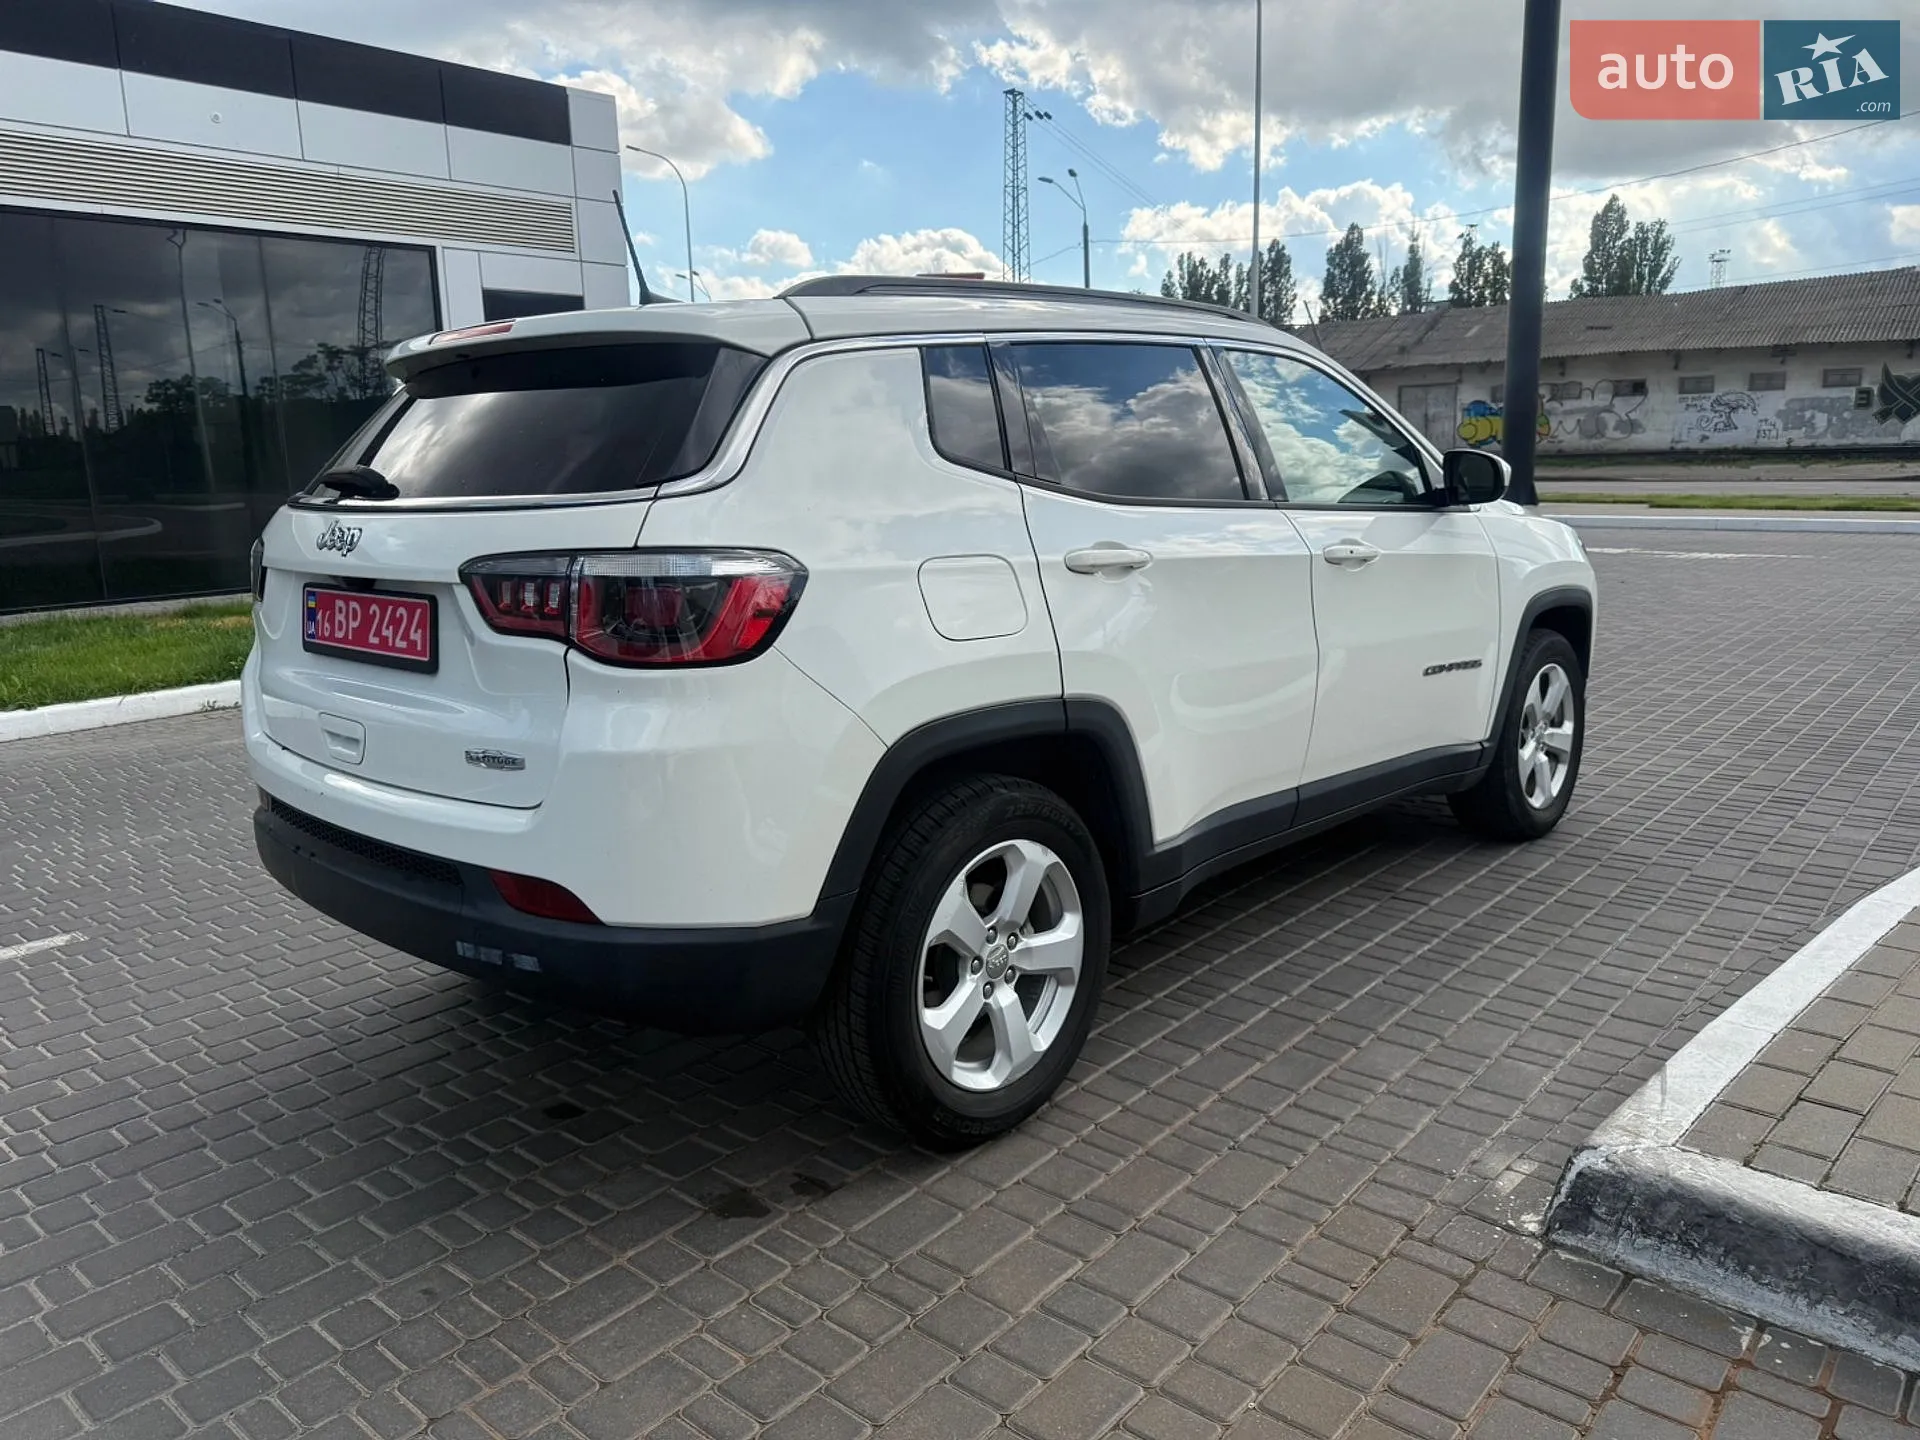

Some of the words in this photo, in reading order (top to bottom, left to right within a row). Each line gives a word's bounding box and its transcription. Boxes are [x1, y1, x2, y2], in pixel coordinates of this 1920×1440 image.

[316, 519, 363, 557] Jeep
[307, 621, 316, 634] UA
[317, 609, 331, 638] 16
[368, 603, 422, 651] 2424
